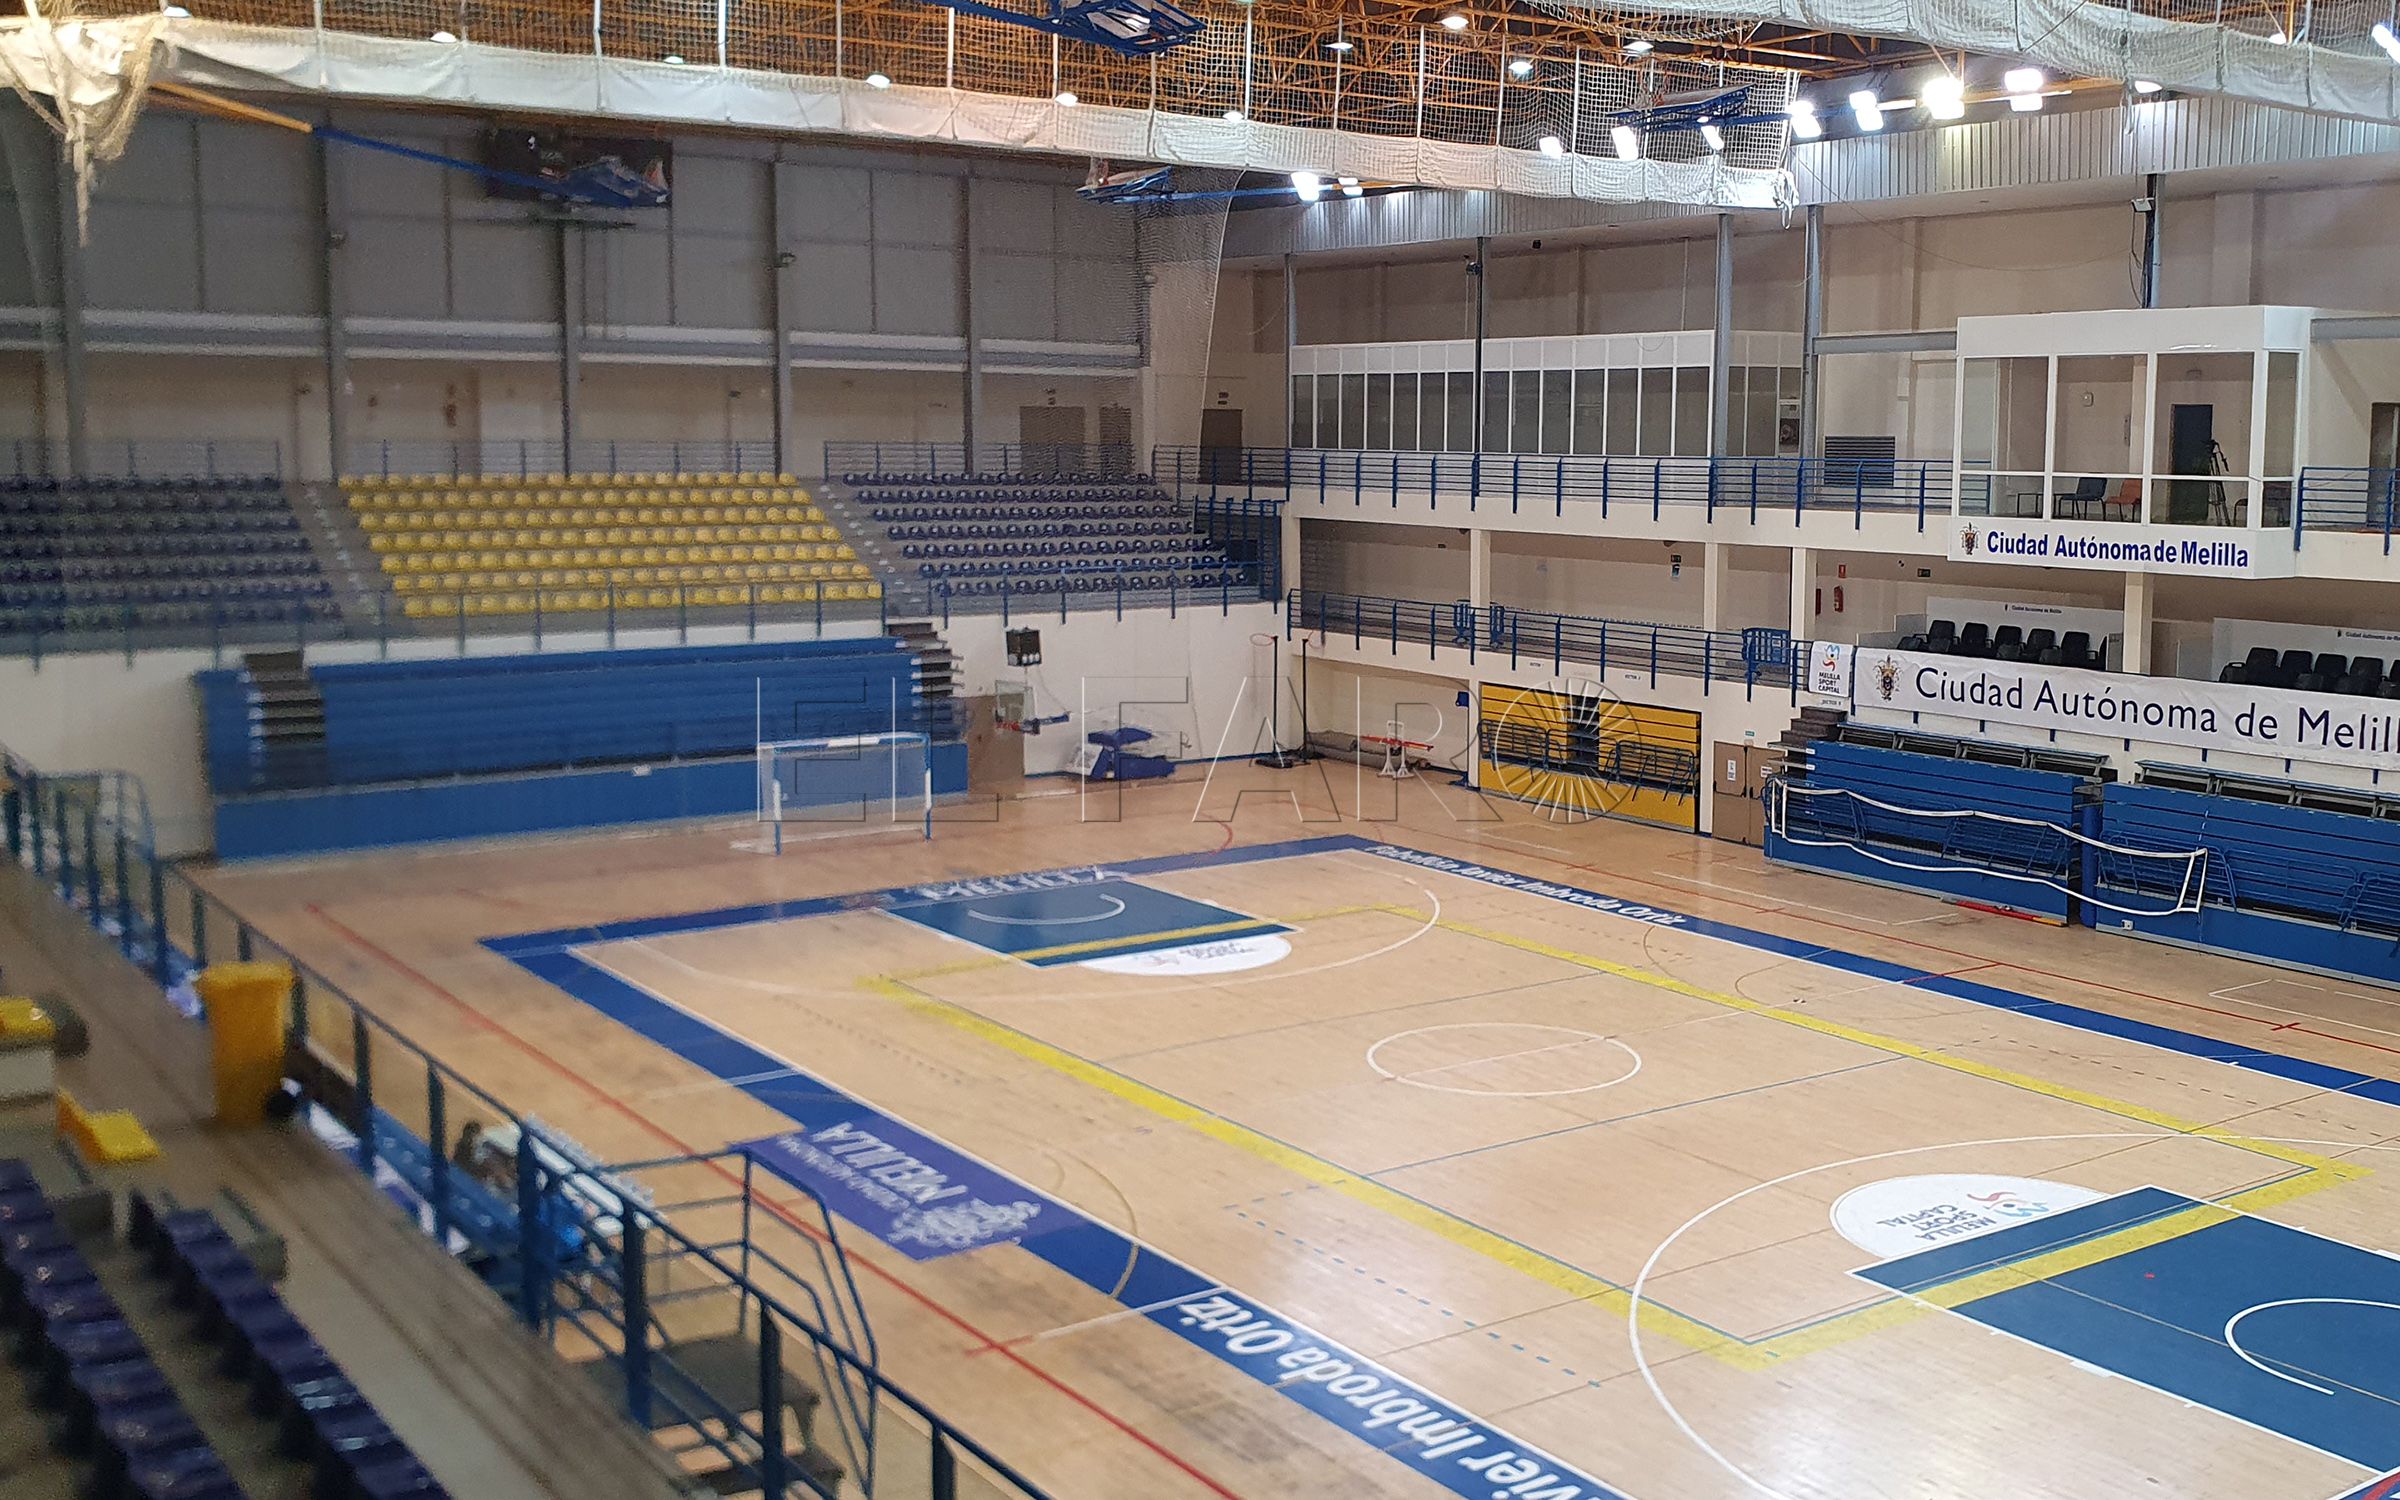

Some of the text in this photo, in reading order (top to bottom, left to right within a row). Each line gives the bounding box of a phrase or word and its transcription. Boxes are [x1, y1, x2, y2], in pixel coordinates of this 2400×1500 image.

[1987, 531, 2248, 567] Ciudad Autónoma de Melilla
[1818, 678, 1837, 687] SPORT
[1819, 672, 1841, 681] MELILLA
[1818, 685, 1840, 694] CAPITAL
[1915, 667, 2023, 709] Ciudad
[2033, 679, 2217, 733] Autónoma
[2235, 702, 2278, 739] de
[1518, 877, 1622, 911] Imbroda
[1618, 905, 1688, 926] Ortiz
[1876, 1204, 1959, 1228] CAPITAL
[1911, 1209, 1978, 1232] SPORT
[1914, 1216, 1998, 1241] MELILLA
[1177, 1295, 1296, 1355] Ortiz
[1275, 1345, 1486, 1460] Imbroda
